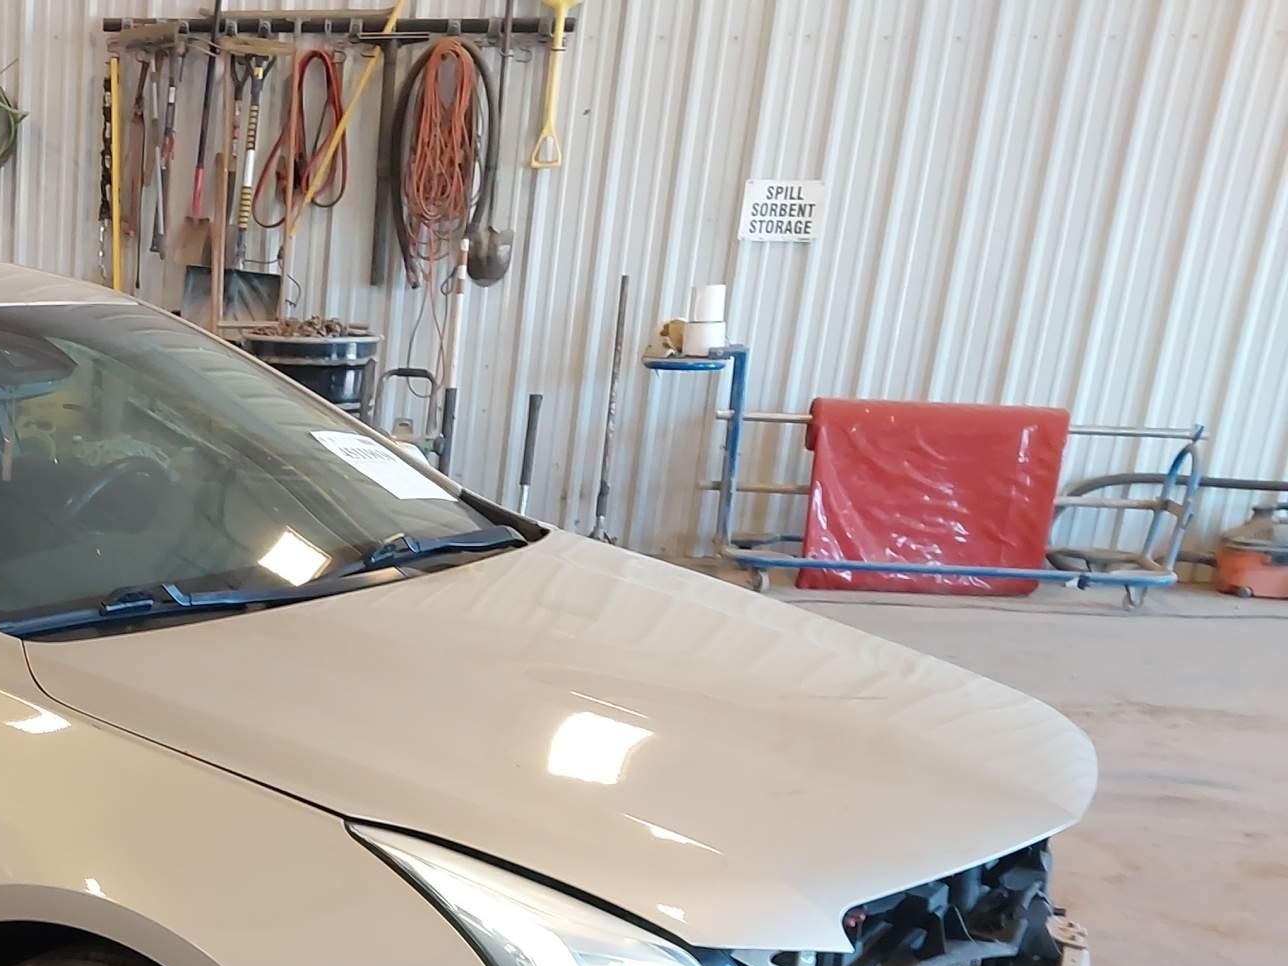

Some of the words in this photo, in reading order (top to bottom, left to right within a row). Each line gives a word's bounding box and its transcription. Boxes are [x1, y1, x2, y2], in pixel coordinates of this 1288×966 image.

[765, 185, 805, 201] SPILL
[751, 202, 817, 218] SORBENT
[748, 219, 813, 235] STORAGE
